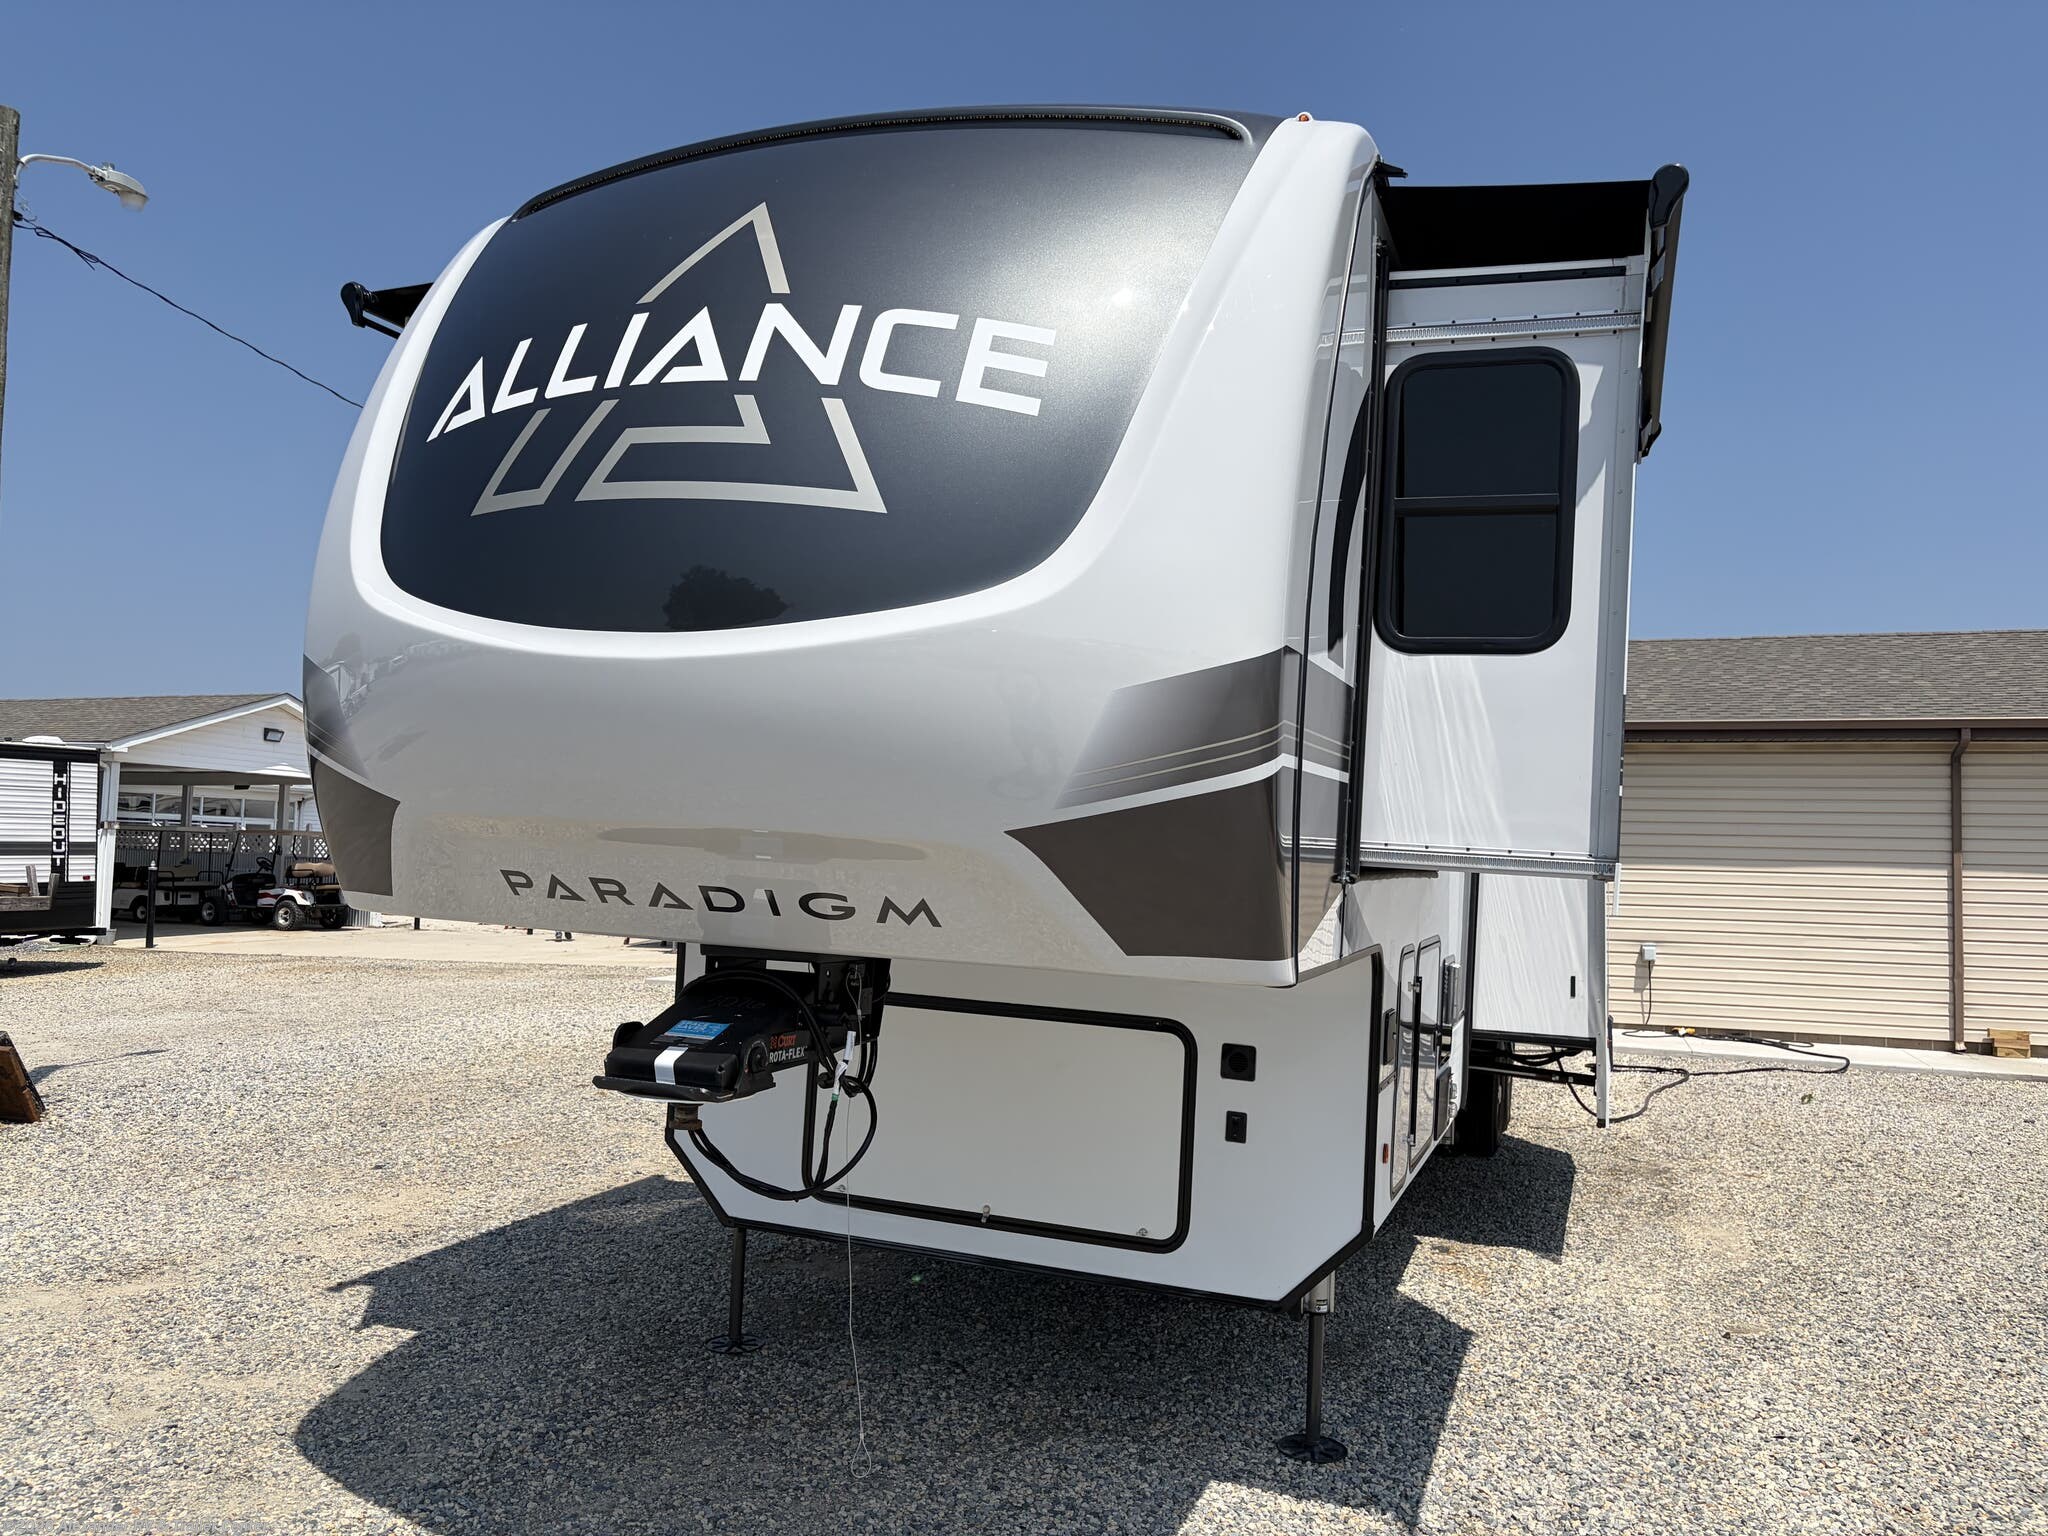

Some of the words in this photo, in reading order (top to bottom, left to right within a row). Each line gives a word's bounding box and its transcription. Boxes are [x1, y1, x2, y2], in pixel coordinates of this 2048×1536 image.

[425, 302, 1057, 443] ALLIANCE
[52, 772, 67, 867] HIDEOUT
[499, 868, 943, 929] PARADIGM
